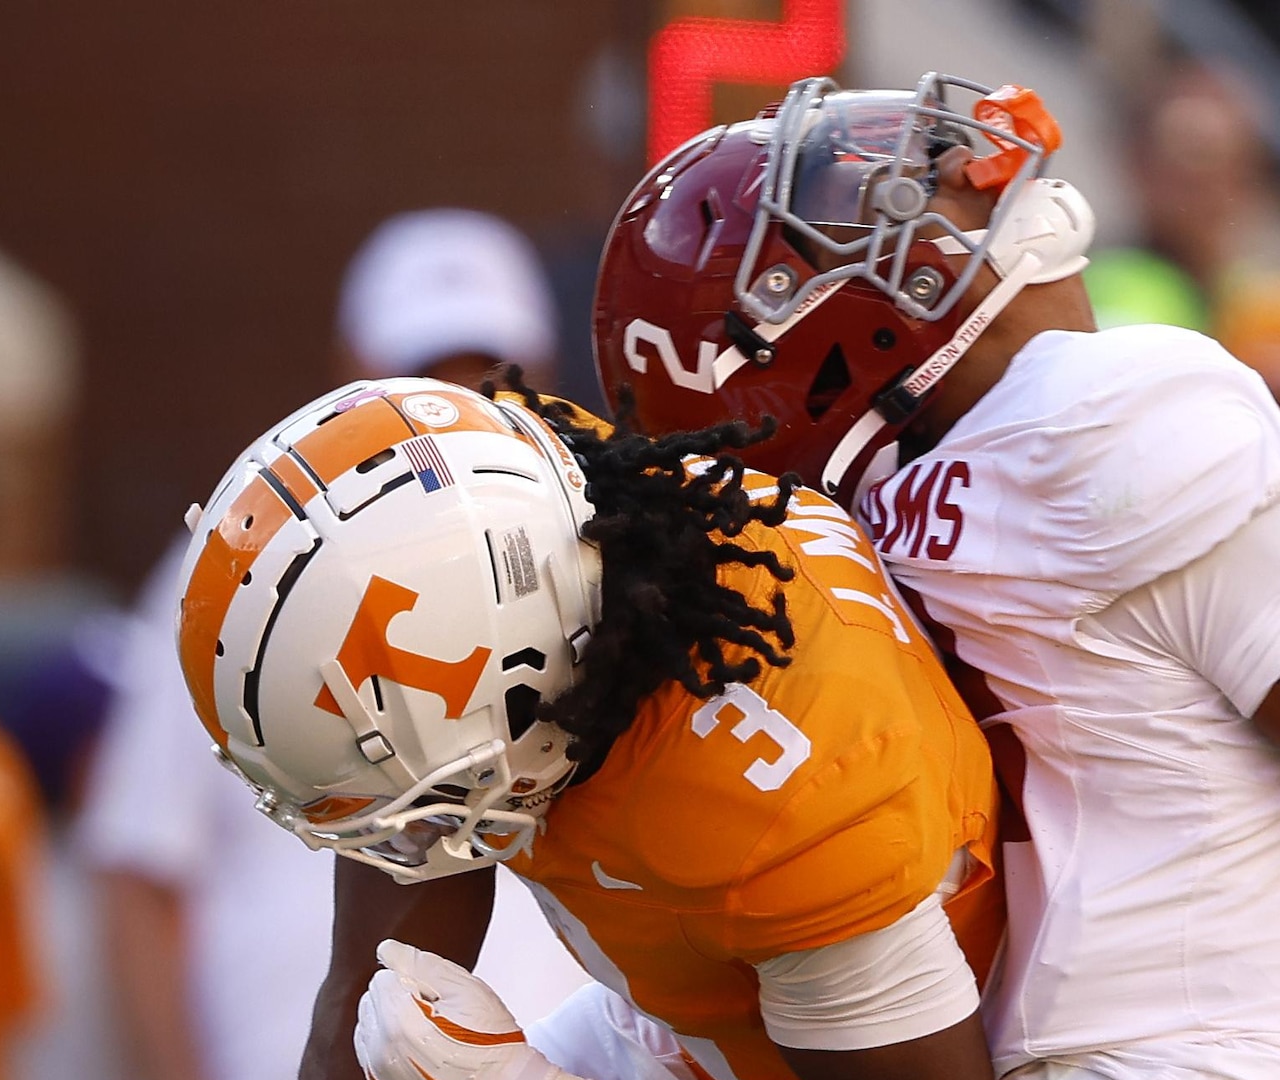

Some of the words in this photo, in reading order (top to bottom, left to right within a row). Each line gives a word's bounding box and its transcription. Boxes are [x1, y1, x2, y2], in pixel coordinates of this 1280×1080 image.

[624, 318, 719, 394] 2
[314, 575, 492, 719] T
[691, 682, 812, 791] 3
